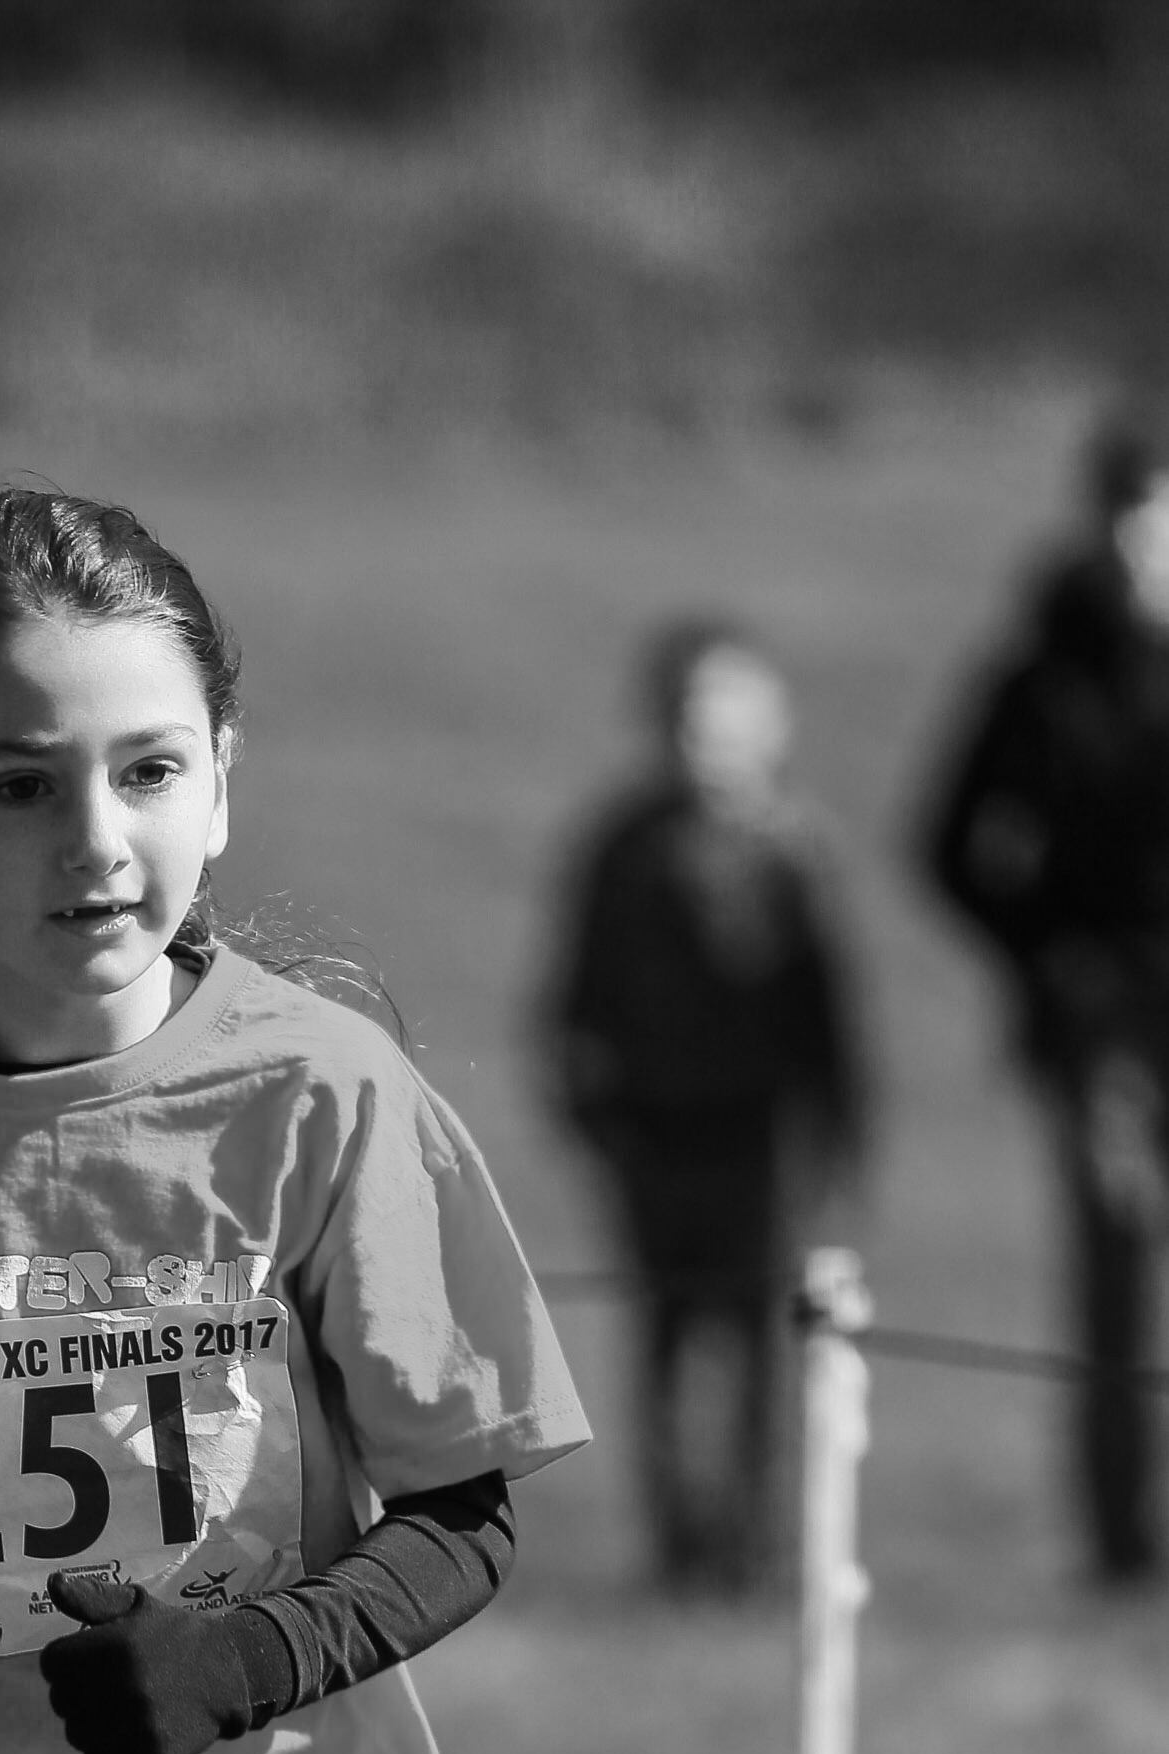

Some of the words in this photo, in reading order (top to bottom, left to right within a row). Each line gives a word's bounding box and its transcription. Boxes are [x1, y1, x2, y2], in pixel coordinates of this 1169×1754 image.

[0, 1339, 48, 1379] XC
[60, 1325, 183, 1374] FINALS
[194, 1317, 278, 1358] 2017
[31, 1591, 40, 1602] &
